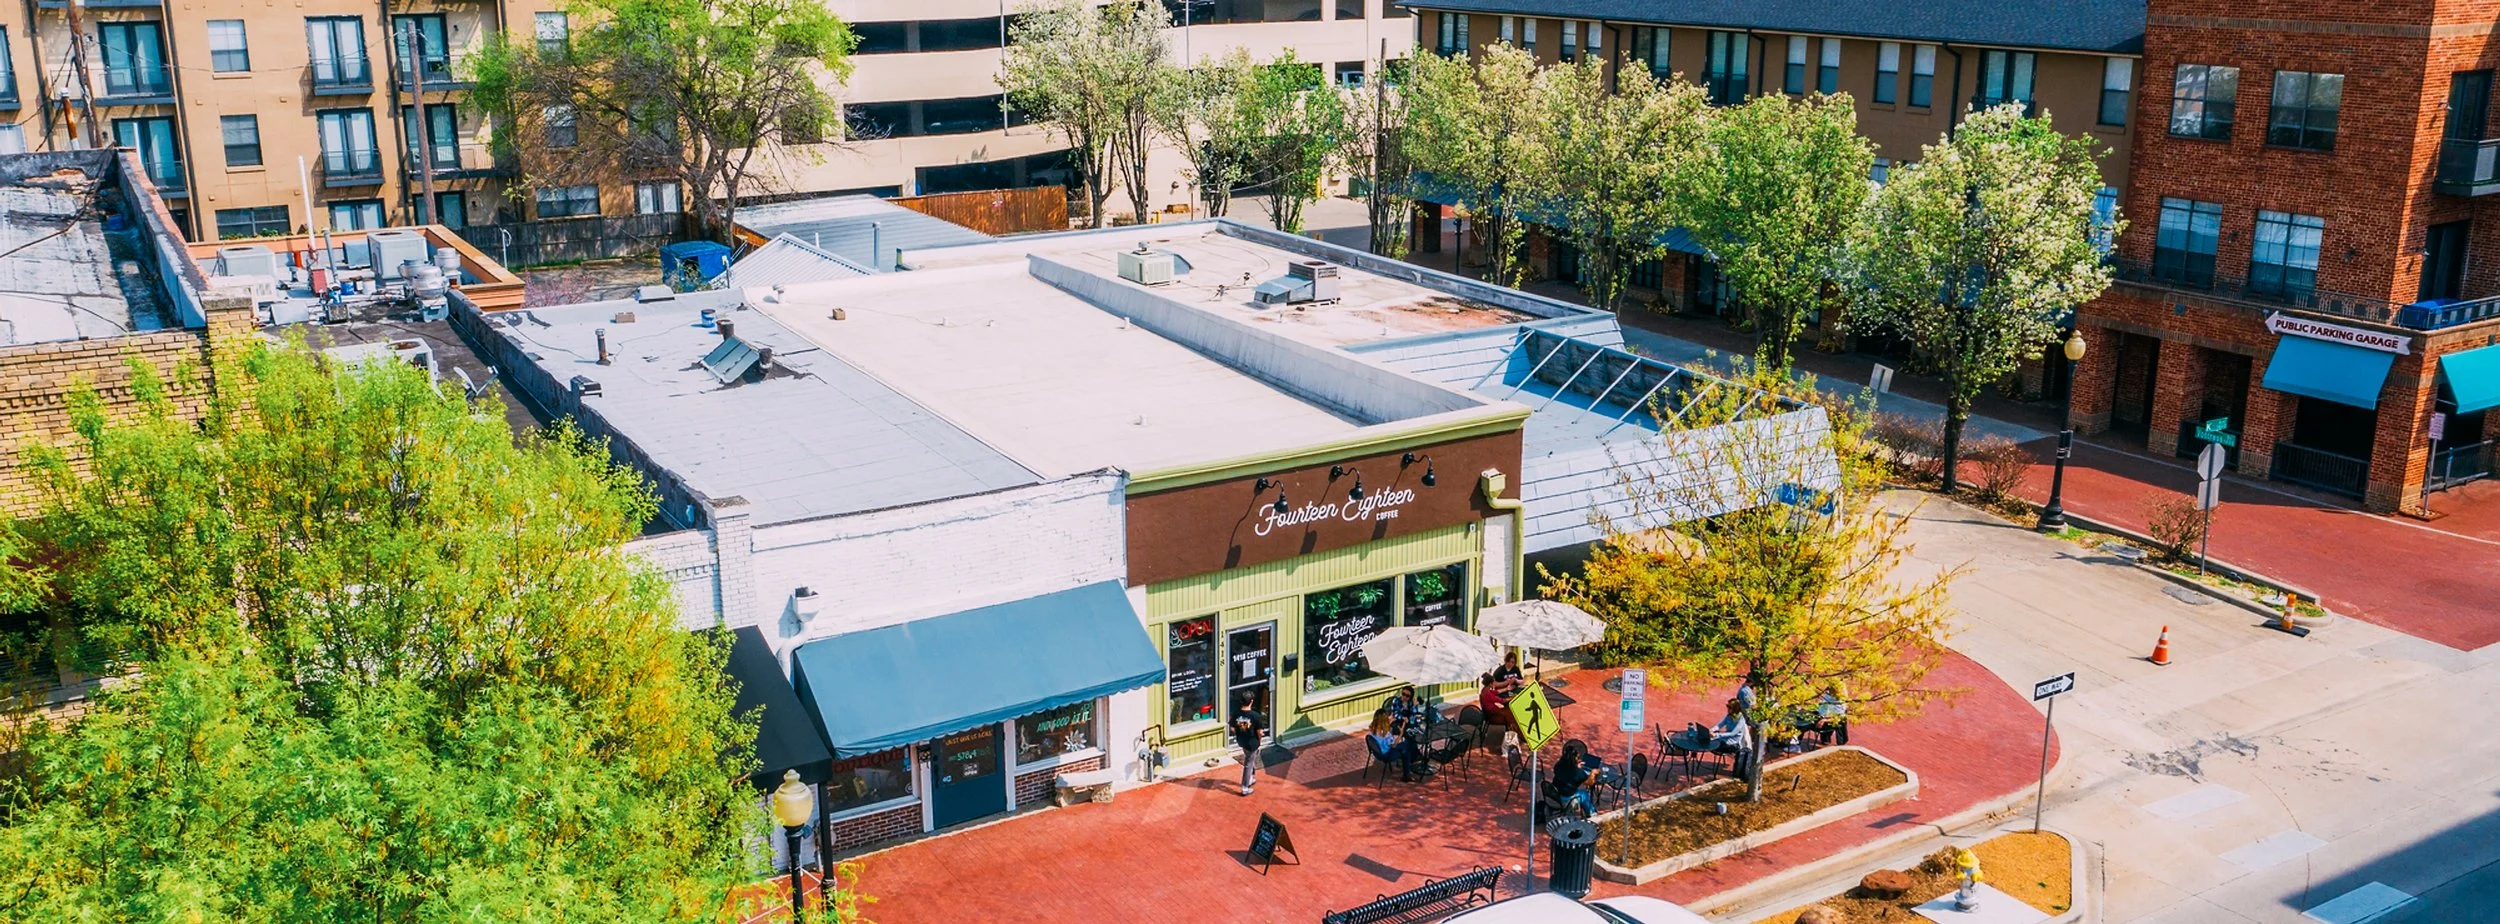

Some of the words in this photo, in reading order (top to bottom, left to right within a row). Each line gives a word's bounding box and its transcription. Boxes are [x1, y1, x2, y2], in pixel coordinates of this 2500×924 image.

[2275, 319, 2308, 333] PUBLIC
[2310, 326, 2354, 341] PARKING
[2355, 333, 2399, 349] GARAGE
[1254, 501, 1339, 536] Fourteen
[1342, 486, 1415, 521] Eighteen
[1376, 509, 1399, 521] COFFEE
[1425, 603, 1442, 612] COFFEE
[1178, 619, 1212, 639] OPEN
[1319, 614, 1375, 648] Fourteen
[1233, 651, 1247, 662] 1418
[1247, 648, 1267, 659] COFFEE
[1326, 632, 1377, 664] Eighteen
